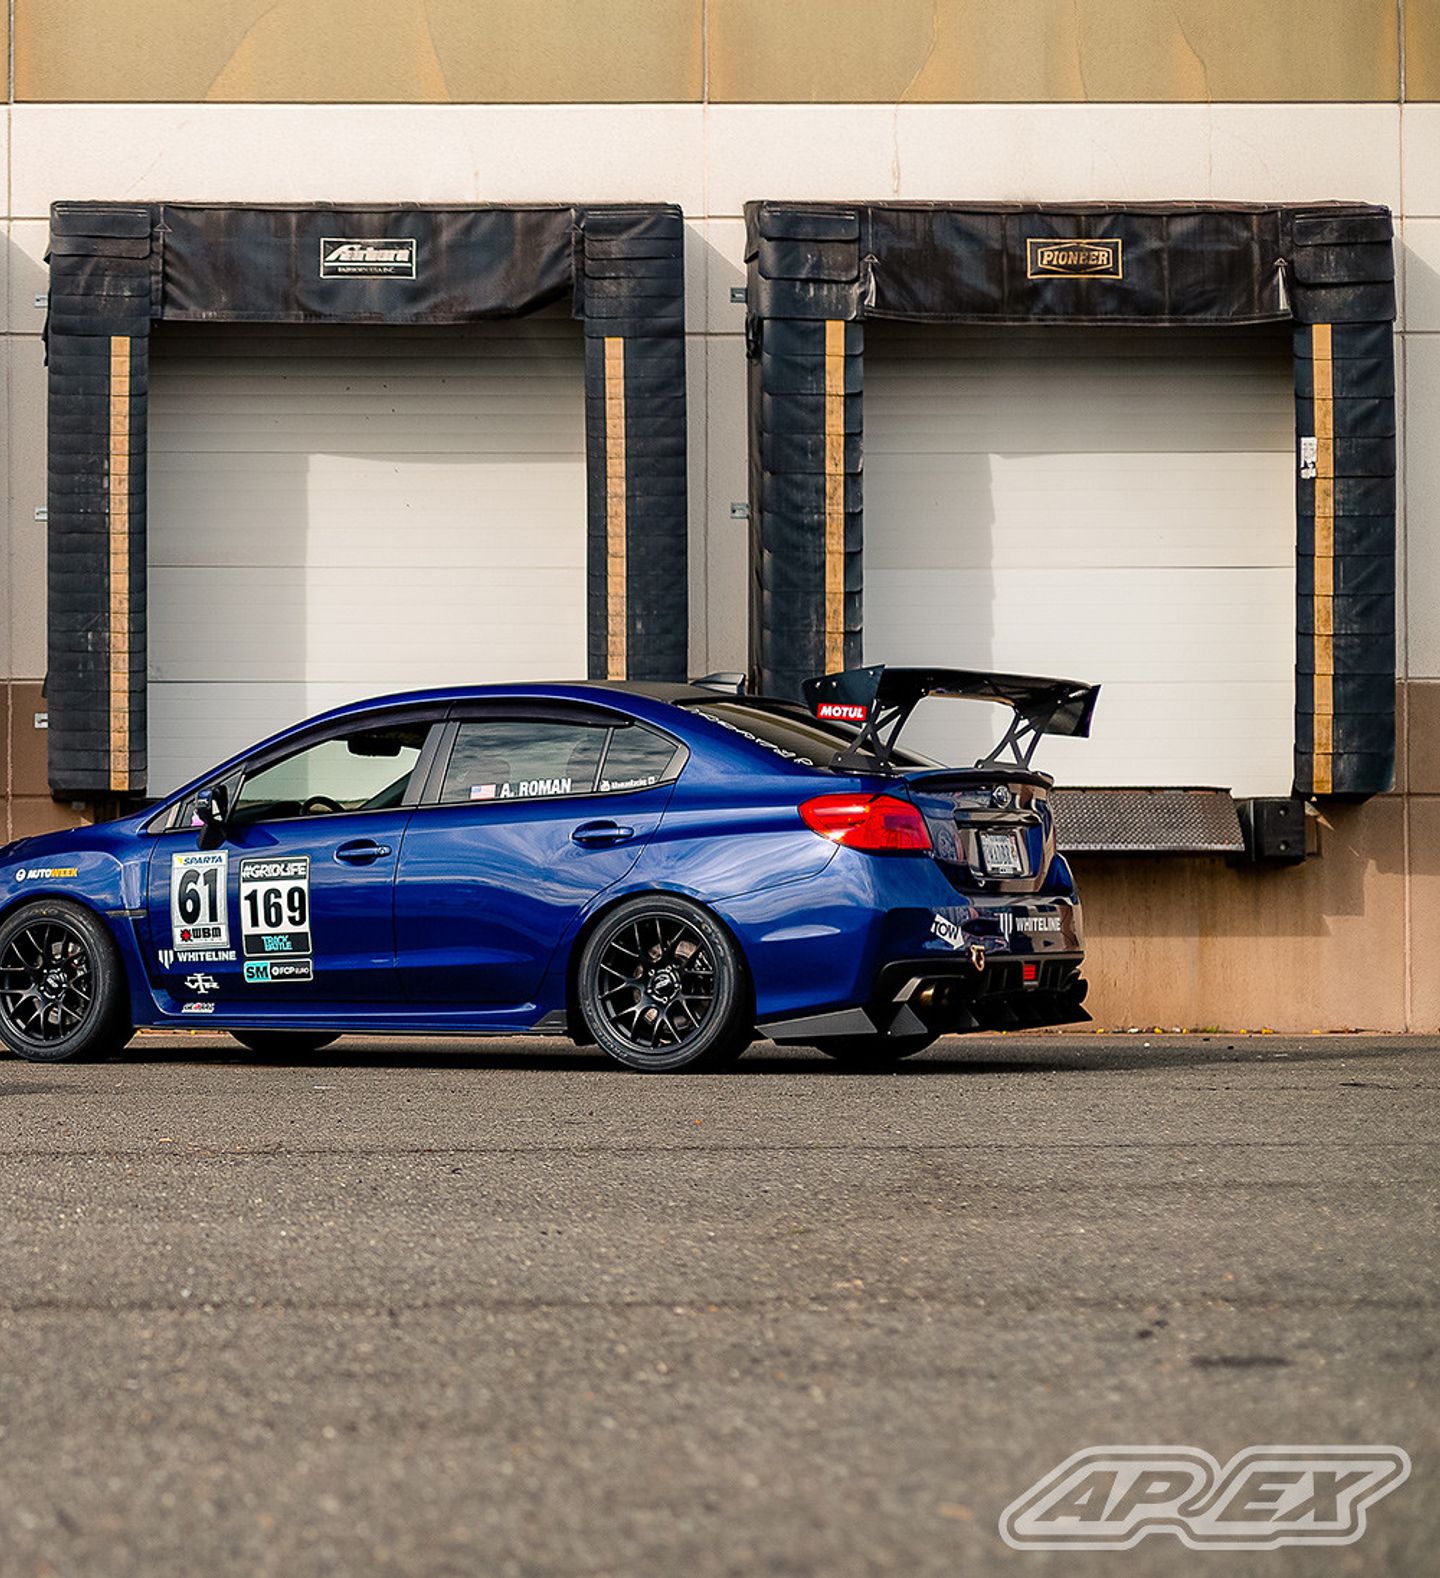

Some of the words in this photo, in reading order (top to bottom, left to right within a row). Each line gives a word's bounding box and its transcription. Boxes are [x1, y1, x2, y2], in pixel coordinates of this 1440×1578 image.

[1042, 251, 1109, 265] PIONEER
[820, 705, 864, 719] MOTUL
[499, 784, 514, 799] A.
[518, 778, 573, 797] ROMAN
[184, 856, 223, 865] SPARTA
[27, 867, 79, 879] AUTOWEEK
[242, 862, 307, 879] #GRIDLIFE
[179, 868, 218, 925] 61
[244, 886, 307, 928] 169
[1015, 917, 1061, 932] WHITELINE
[177, 951, 237, 962] WHITELINE
[246, 966, 269, 979] SM
